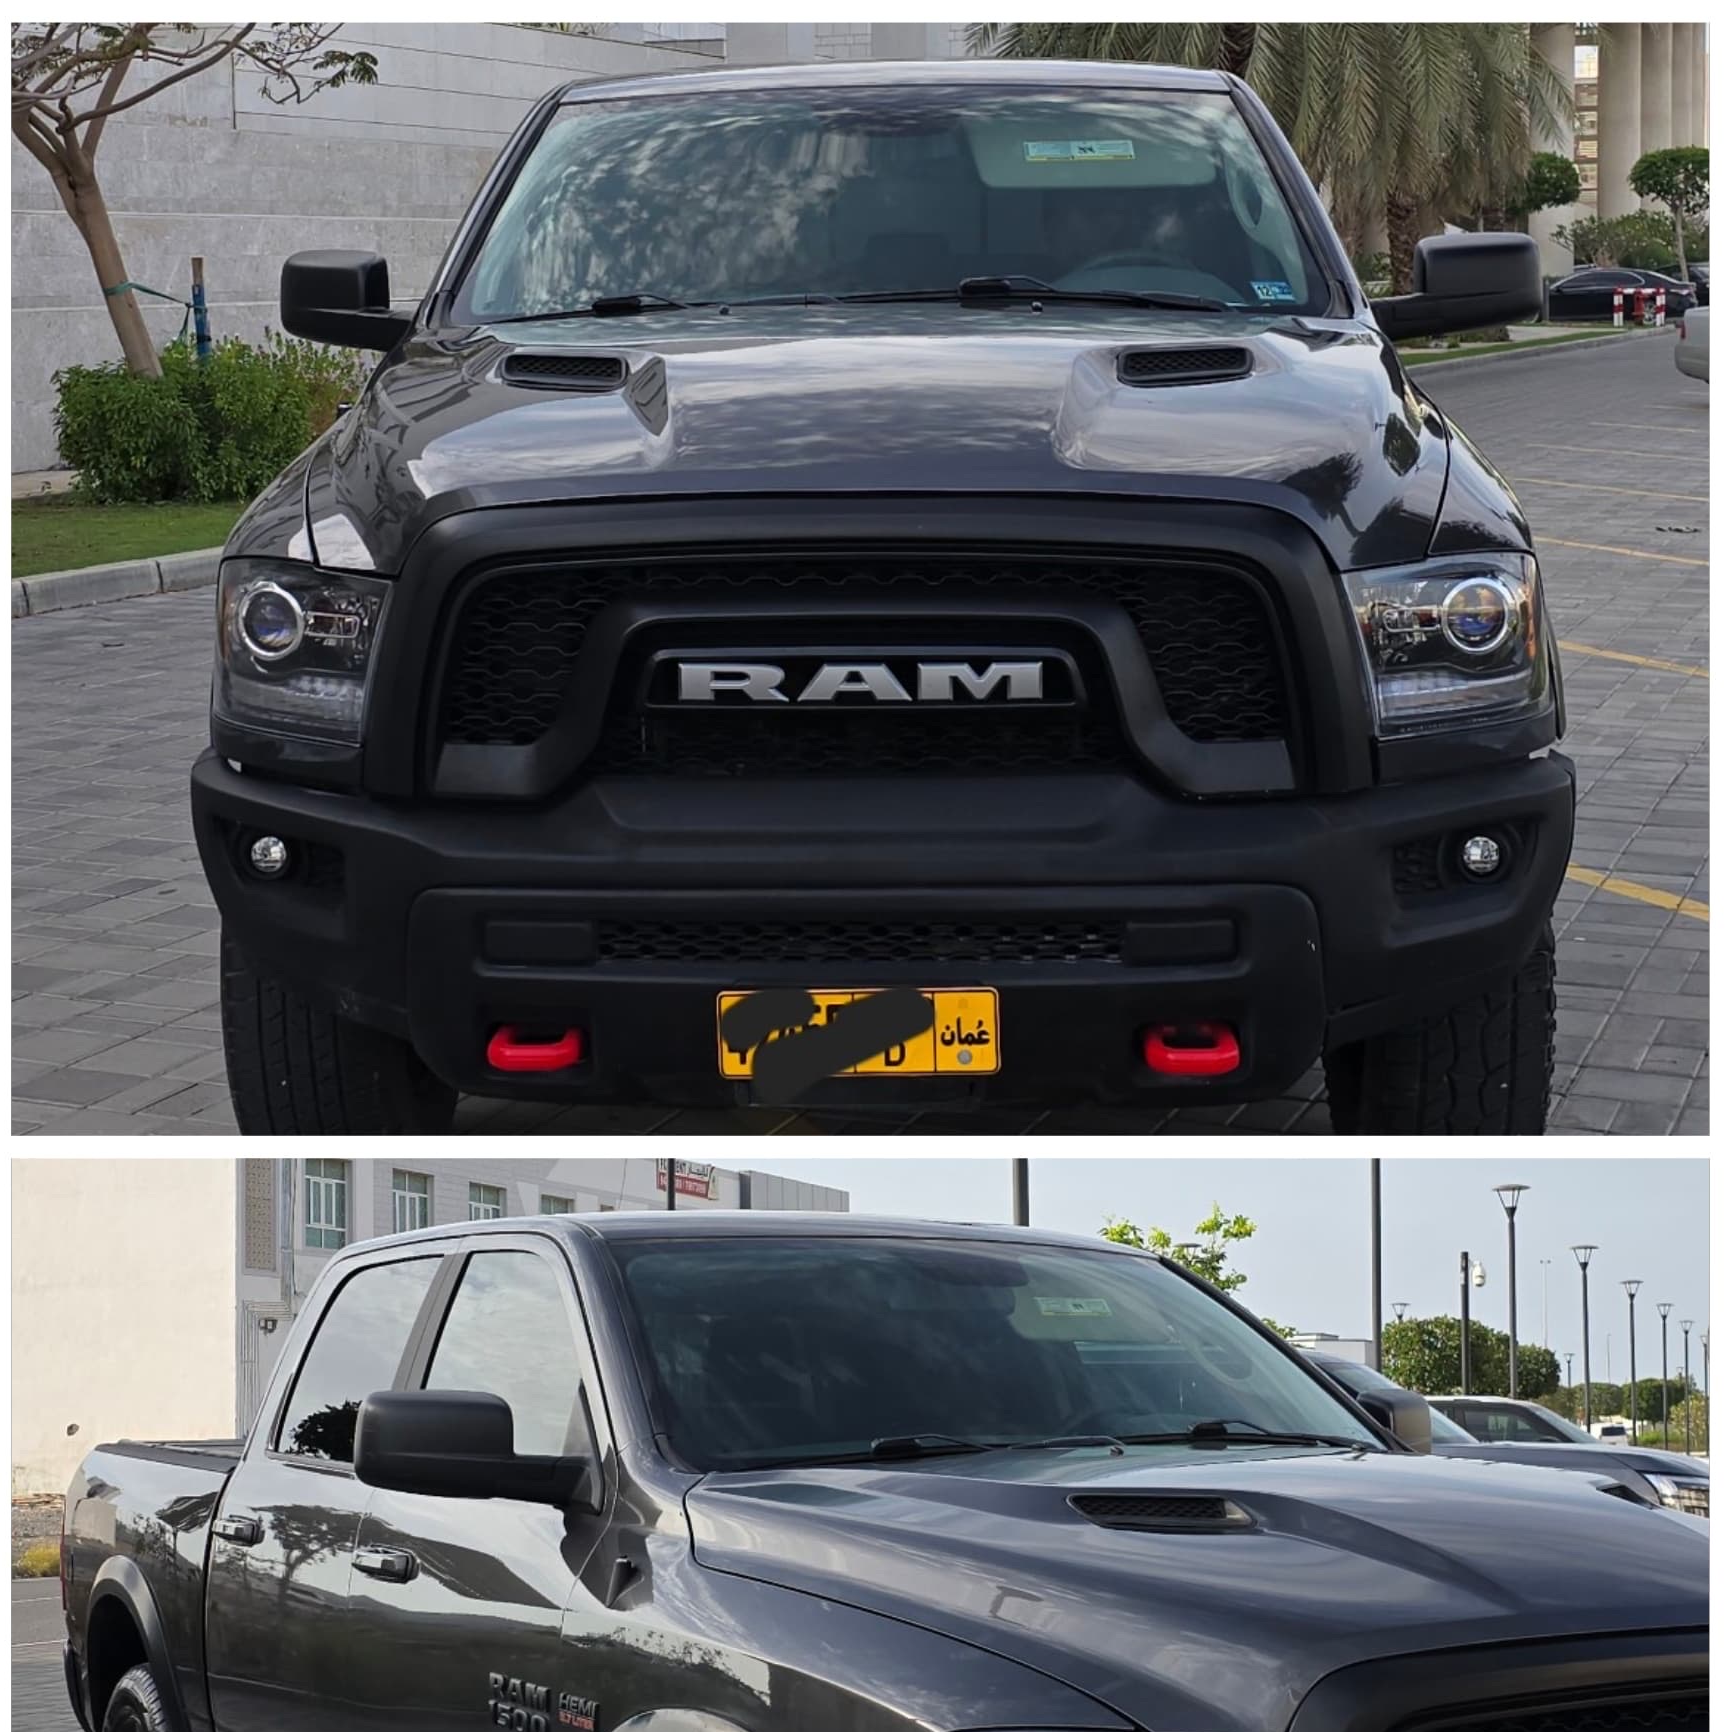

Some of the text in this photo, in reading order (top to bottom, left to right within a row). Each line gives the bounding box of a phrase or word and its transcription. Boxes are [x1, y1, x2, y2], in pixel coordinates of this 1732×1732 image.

[678, 662, 1044, 702] RAM
[489, 1672, 550, 1713] RAM
[559, 1692, 599, 1719] HEMI
